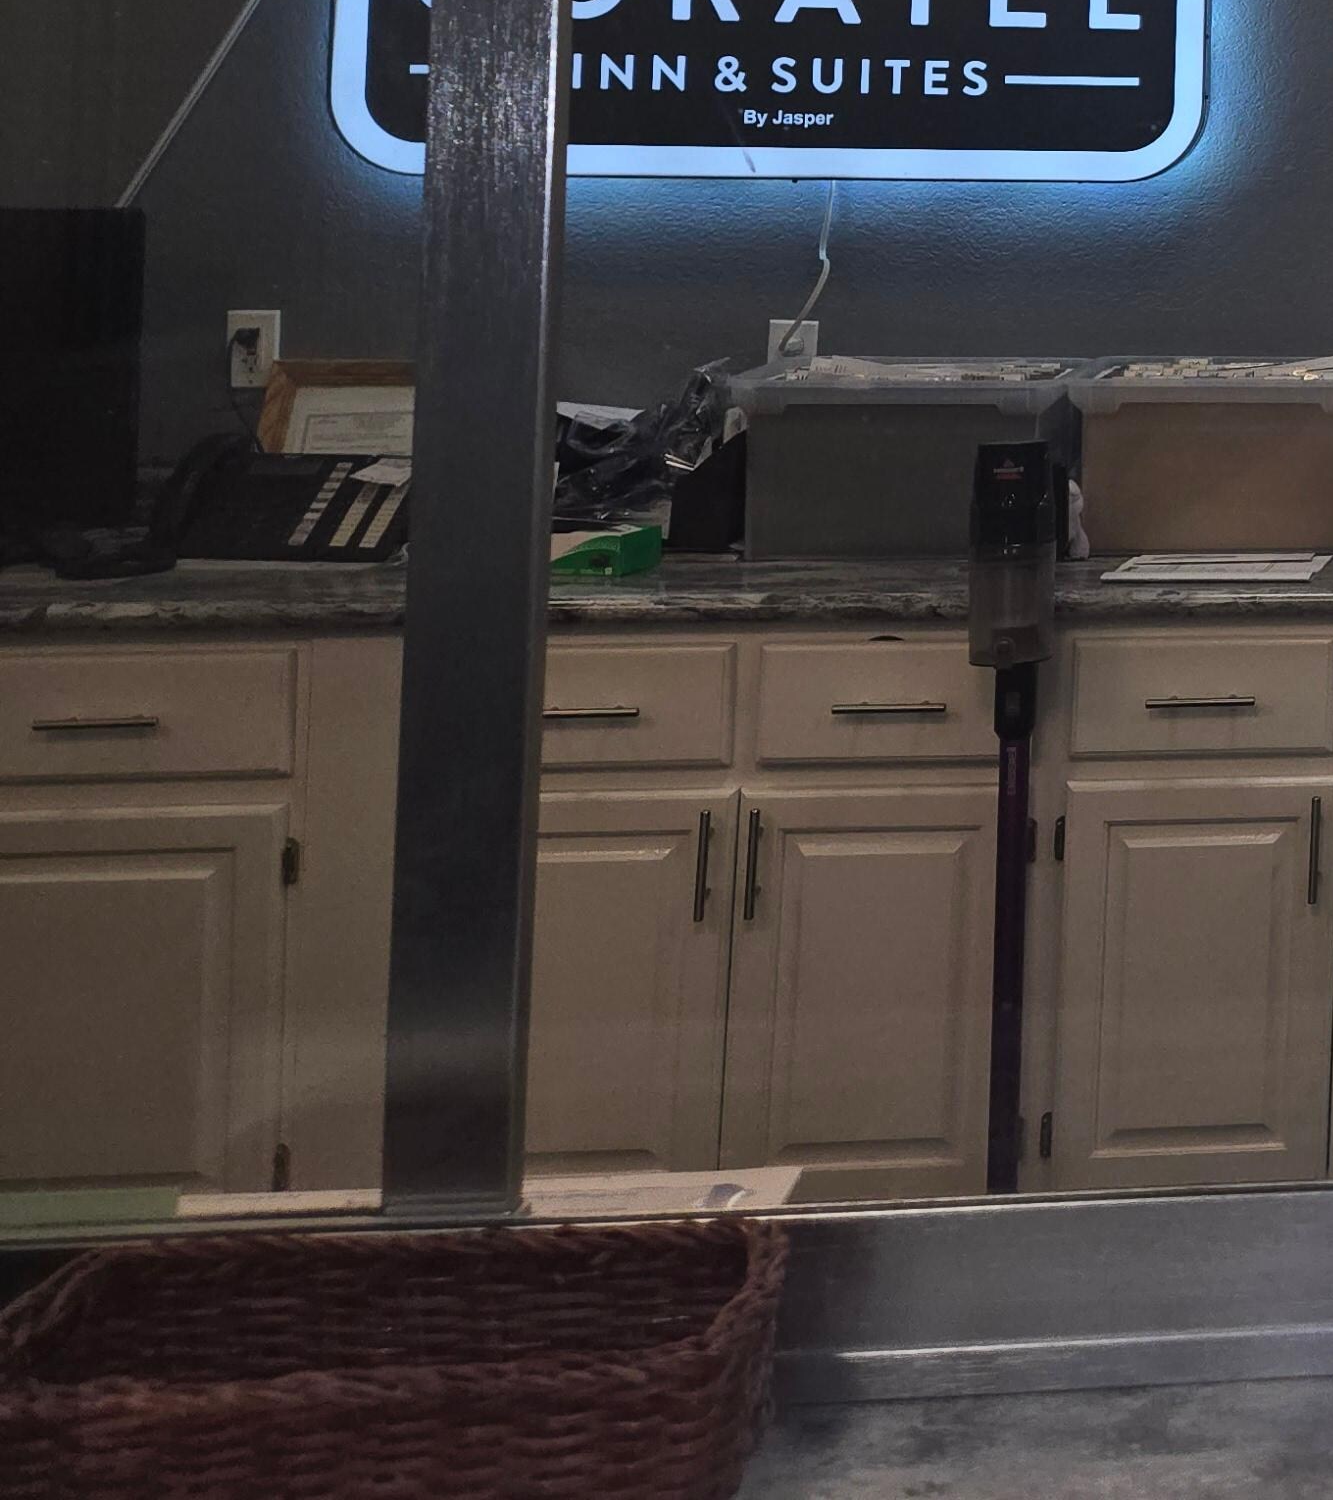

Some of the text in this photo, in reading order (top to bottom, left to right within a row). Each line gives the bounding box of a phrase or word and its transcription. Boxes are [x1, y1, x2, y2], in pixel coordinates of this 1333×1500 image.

[572, 52, 988, 97] INN & SUITES
[742, 109, 834, 128] By Jasper
